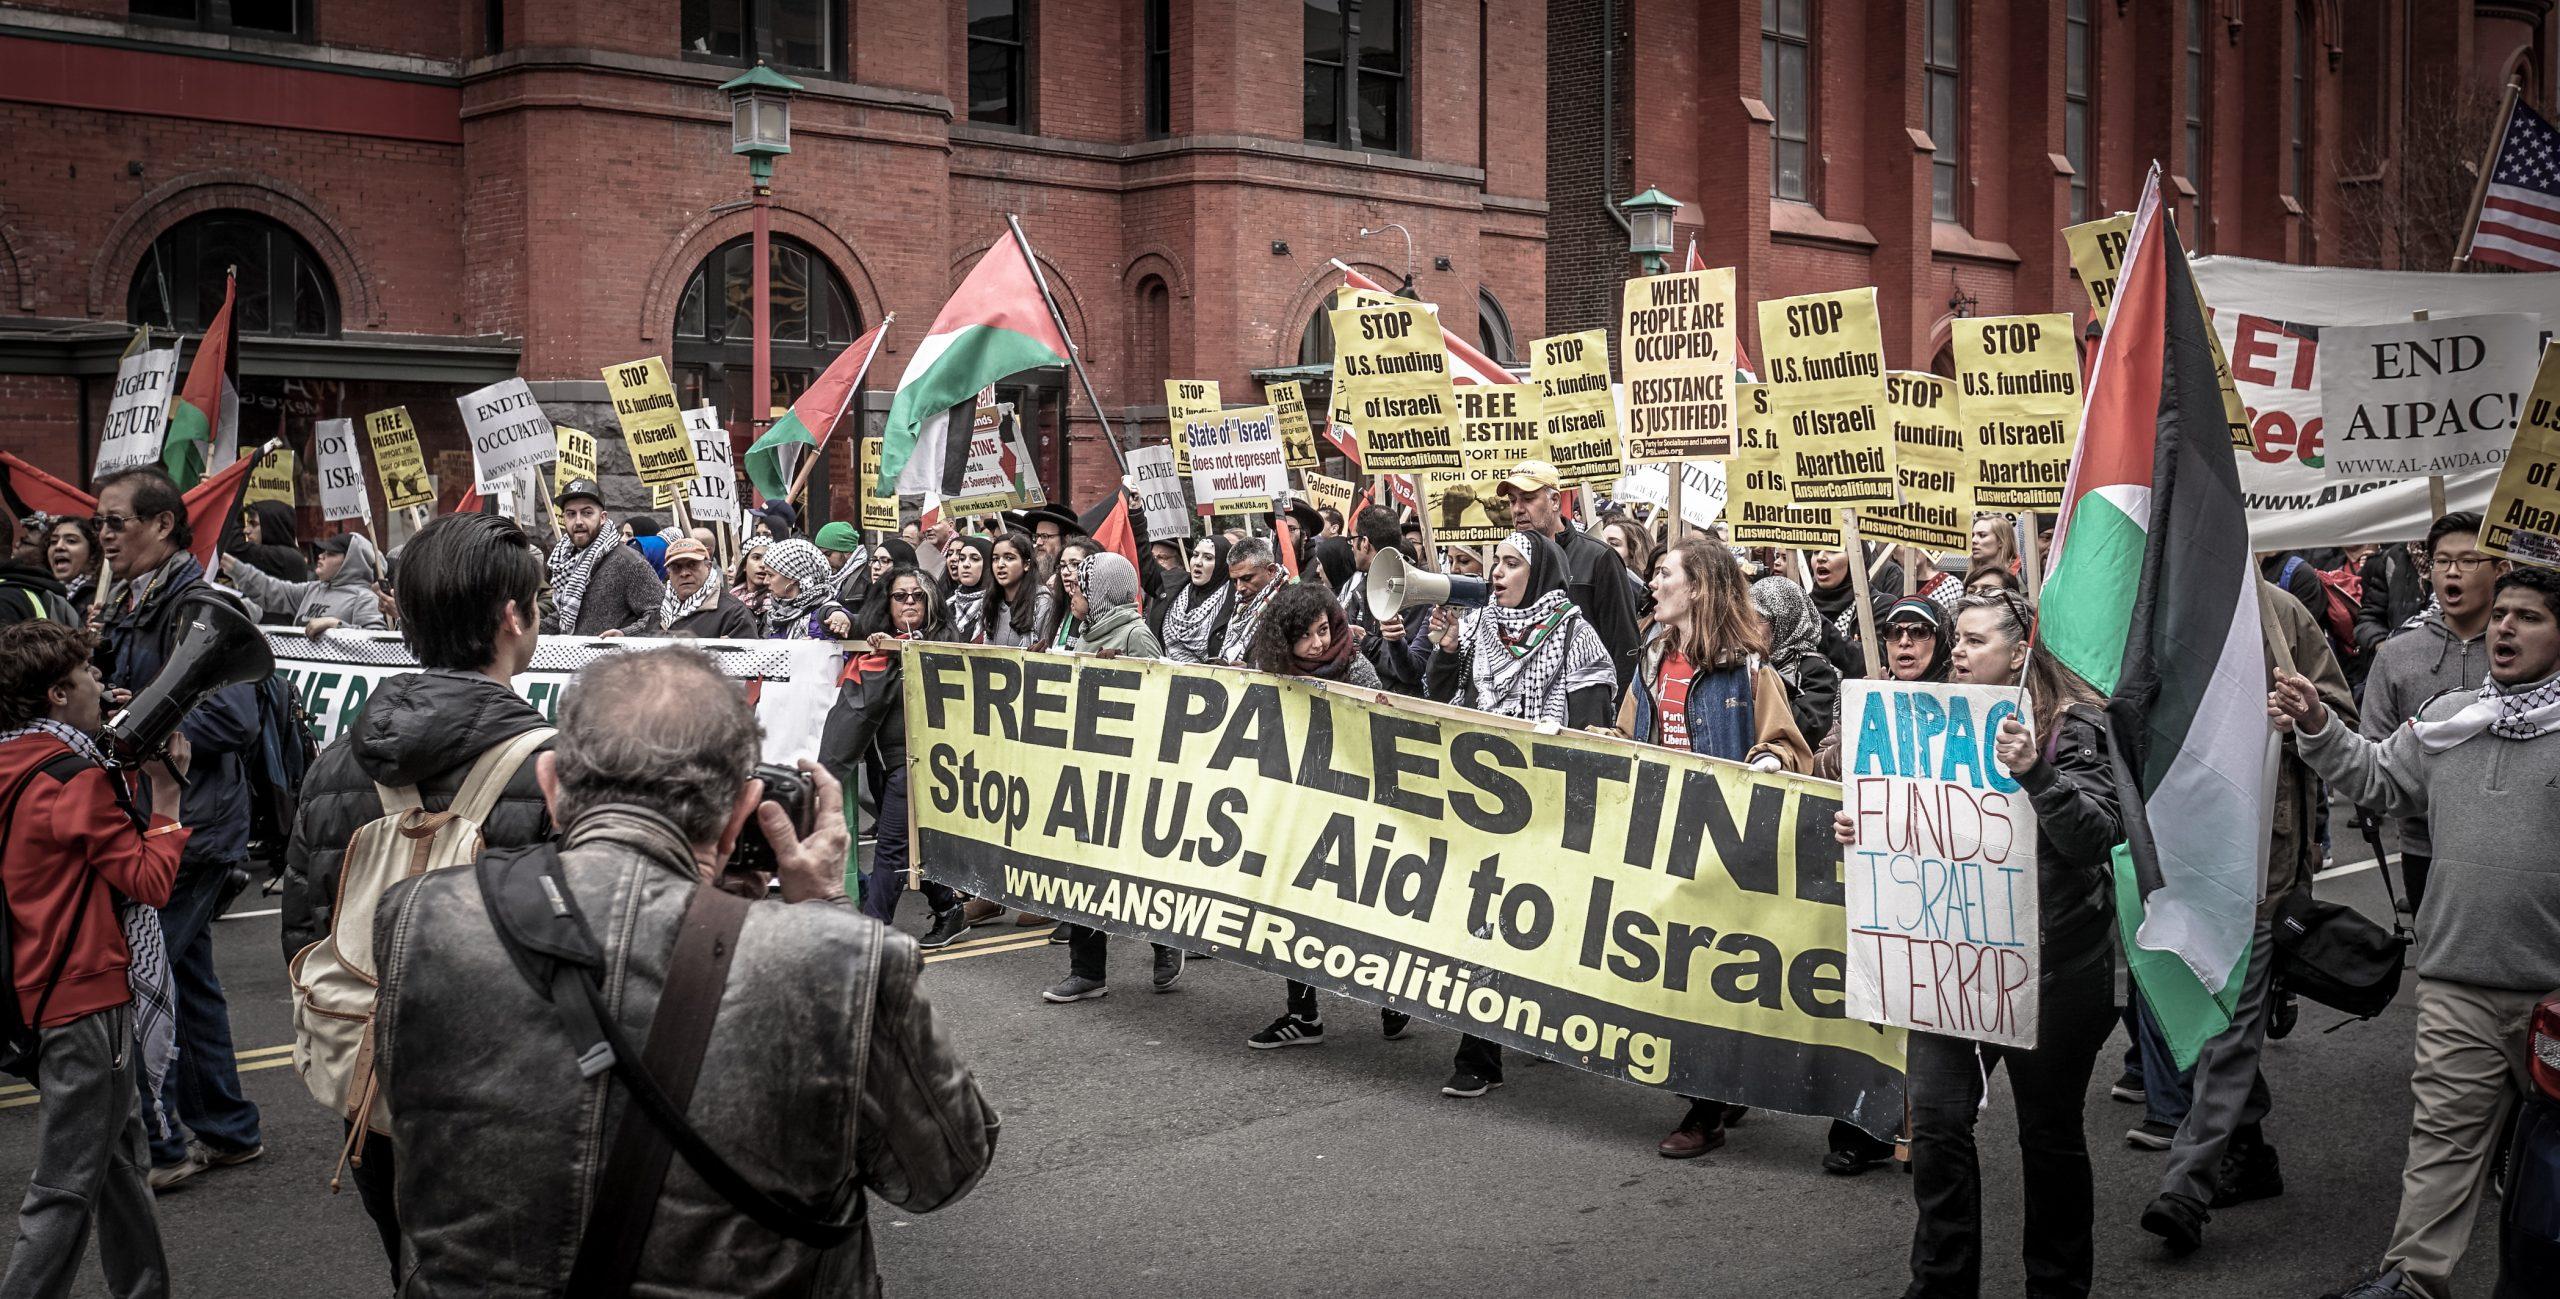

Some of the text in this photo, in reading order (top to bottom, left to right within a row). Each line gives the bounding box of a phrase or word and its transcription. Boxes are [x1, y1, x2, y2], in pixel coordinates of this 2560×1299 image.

[1651, 277, 1699, 307] WHEN
[1360, 311, 1413, 340] STOP
[1630, 302, 1724, 336] PEOPLE ARE
[1786, 300, 1843, 338] STOP
[1635, 332, 1718, 362] OCCUPIED,
[1982, 322, 2041, 355] STOP
[1345, 351, 1444, 377] U.S. funding
[1545, 338, 1584, 366] STOP
[2371, 334, 2487, 380] END
[619, 365, 649, 388] STOP
[1771, 351, 1879, 384] U.S. funding
[1179, 384, 1205, 400] STOP
[1274, 386, 1295, 403] FREE
[1557, 373, 1607, 395] funding
[1632, 375, 1724, 405] RESISTANCE
[1887, 377, 1943, 409] STOP
[1962, 368, 2075, 396] U.S. funding
[476, 397, 514, 422] END
[616, 393, 675, 416] U.S. funding
[1365, 397, 1383, 418] of
[1383, 393, 1442, 417] Israeli
[2342, 391, 2519, 441] AIPAC!
[375, 413, 403, 434] FREE
[1187, 414, 1275, 449] State of "Israel"
[1463, 421, 1539, 442] ESTINE
[1548, 410, 1606, 435] of Israeli
[1630, 404, 1728, 437] IS JUSTIFIED!
[1792, 405, 1877, 436] of Israeli
[1979, 419, 2065, 445] of Israeli
[372, 429, 415, 450] PALESTINE
[633, 423, 678, 446] of Israeli
[1368, 426, 1450, 452] Apartheid
[1663, 438, 1689, 447] Socialism
[1689, 437, 1699, 446] and
[1700, 437, 1728, 445] Liberation
[402, 445, 413, 454] THE
[638, 447, 688, 470] Apartheid
[1192, 454, 1214, 472] does
[1215, 451, 1234, 470] not
[1235, 448, 1282, 469] represent
[1505, 448, 1528, 459] THE
[1550, 438, 1613, 464] Apartheid
[1796, 447, 1885, 478] Apartheid
[968, 474, 1005, 489] Sovereignty
[1212, 474, 1266, 492] world Jewry
[1471, 469, 1487, 481] OF
[1493, 469, 1510, 480] RET
[1746, 470, 1764, 490] of
[1897, 464, 1955, 494] sraeli
[1979, 458, 2071, 485] Apartheid
[2526, 462, 2557, 488] of
[258, 477, 291, 493] funding
[1307, 475, 1351, 500] Palestine
[1794, 481, 1893, 500] AnswerCoalition.org
[865, 504, 894, 518] Apartheid
[953, 498, 1008, 513] www.nkusa.org
[1220, 500, 1269, 511] www.NKUSA.org
[1737, 527, 1839, 545] AnswerCoalition.org
[919, 652, 1142, 758] FREE
[1662, 711, 1685, 723] Party
[1858, 777, 2013, 864] FUNDS
[929, 743, 1848, 1019] Stop All U.S. Aid to Israe
[1857, 851, 2025, 946] ISRAELI
[1004, 864, 1672, 1085] www.ANSWERcoalition.org
[1851, 928, 2029, 1038] TERROR
